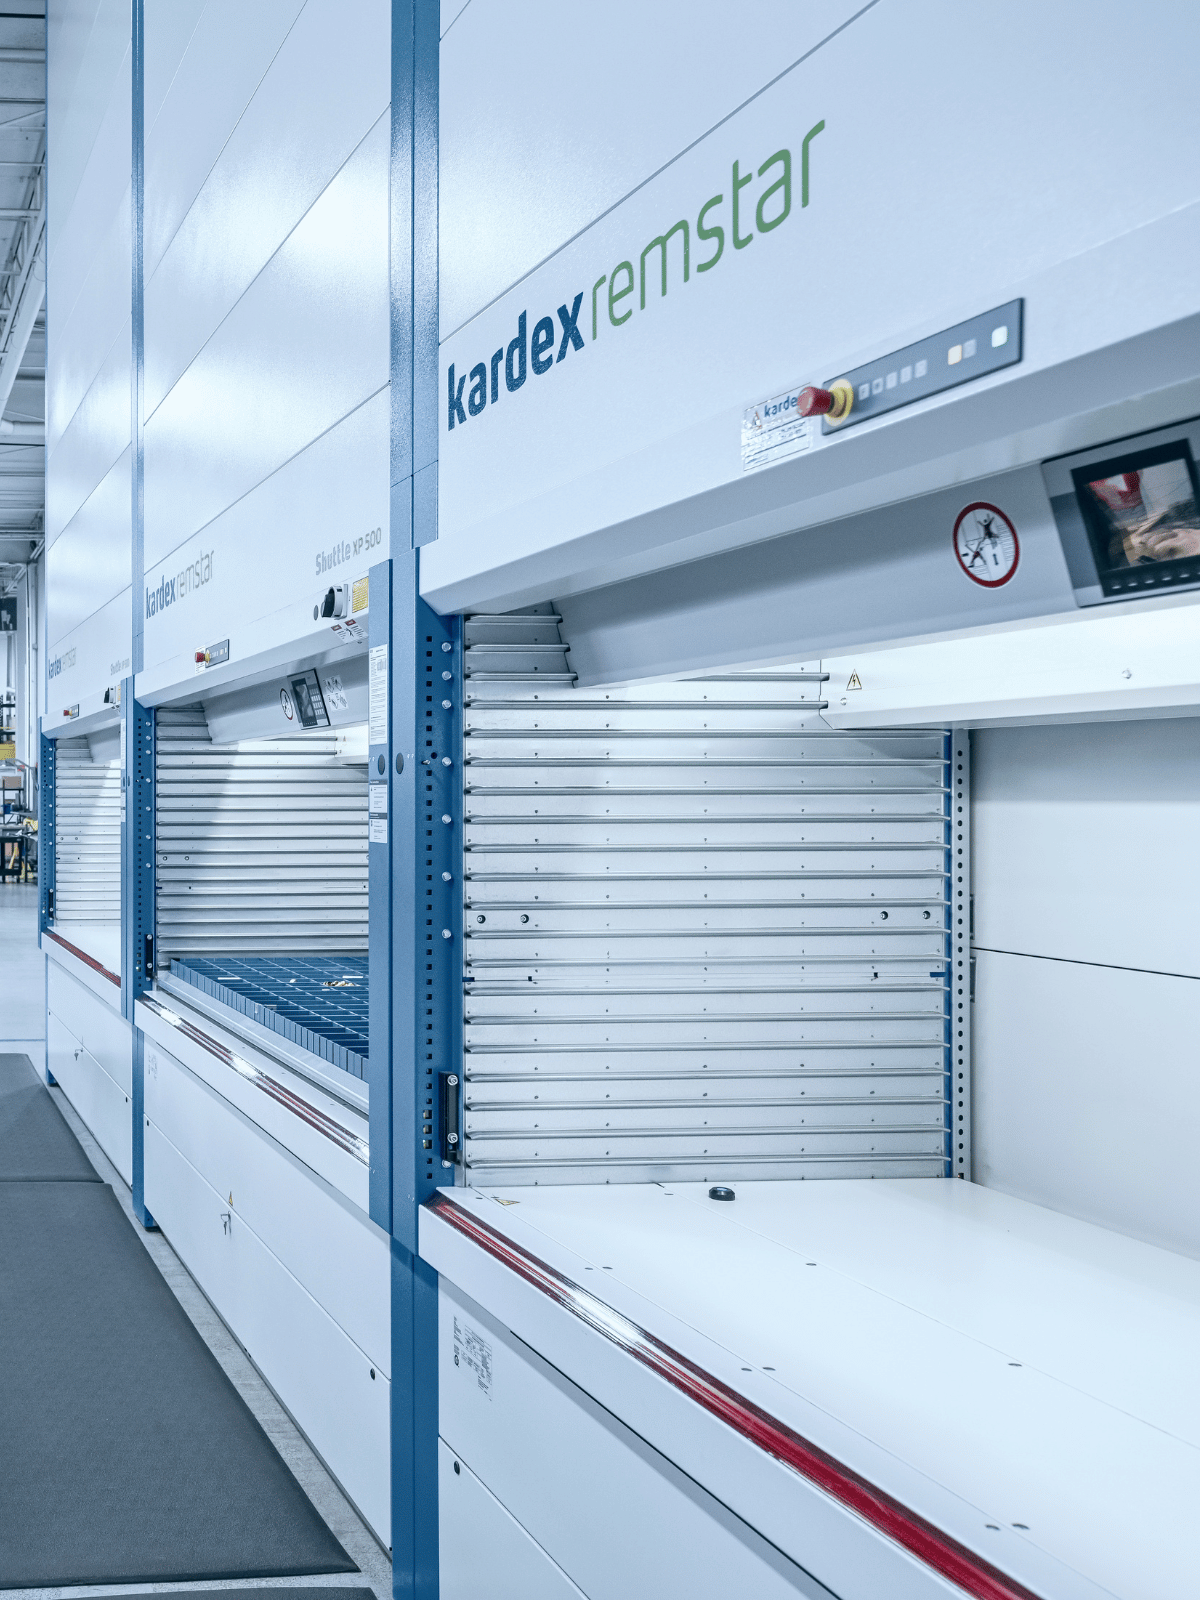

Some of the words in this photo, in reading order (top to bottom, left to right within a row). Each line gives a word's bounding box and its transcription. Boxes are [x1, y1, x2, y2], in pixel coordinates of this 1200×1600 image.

[763, 395, 798, 418] karde
[315, 540, 351, 576] Shuttle
[352, 536, 364, 558] XP
[364, 526, 382, 551] 500
